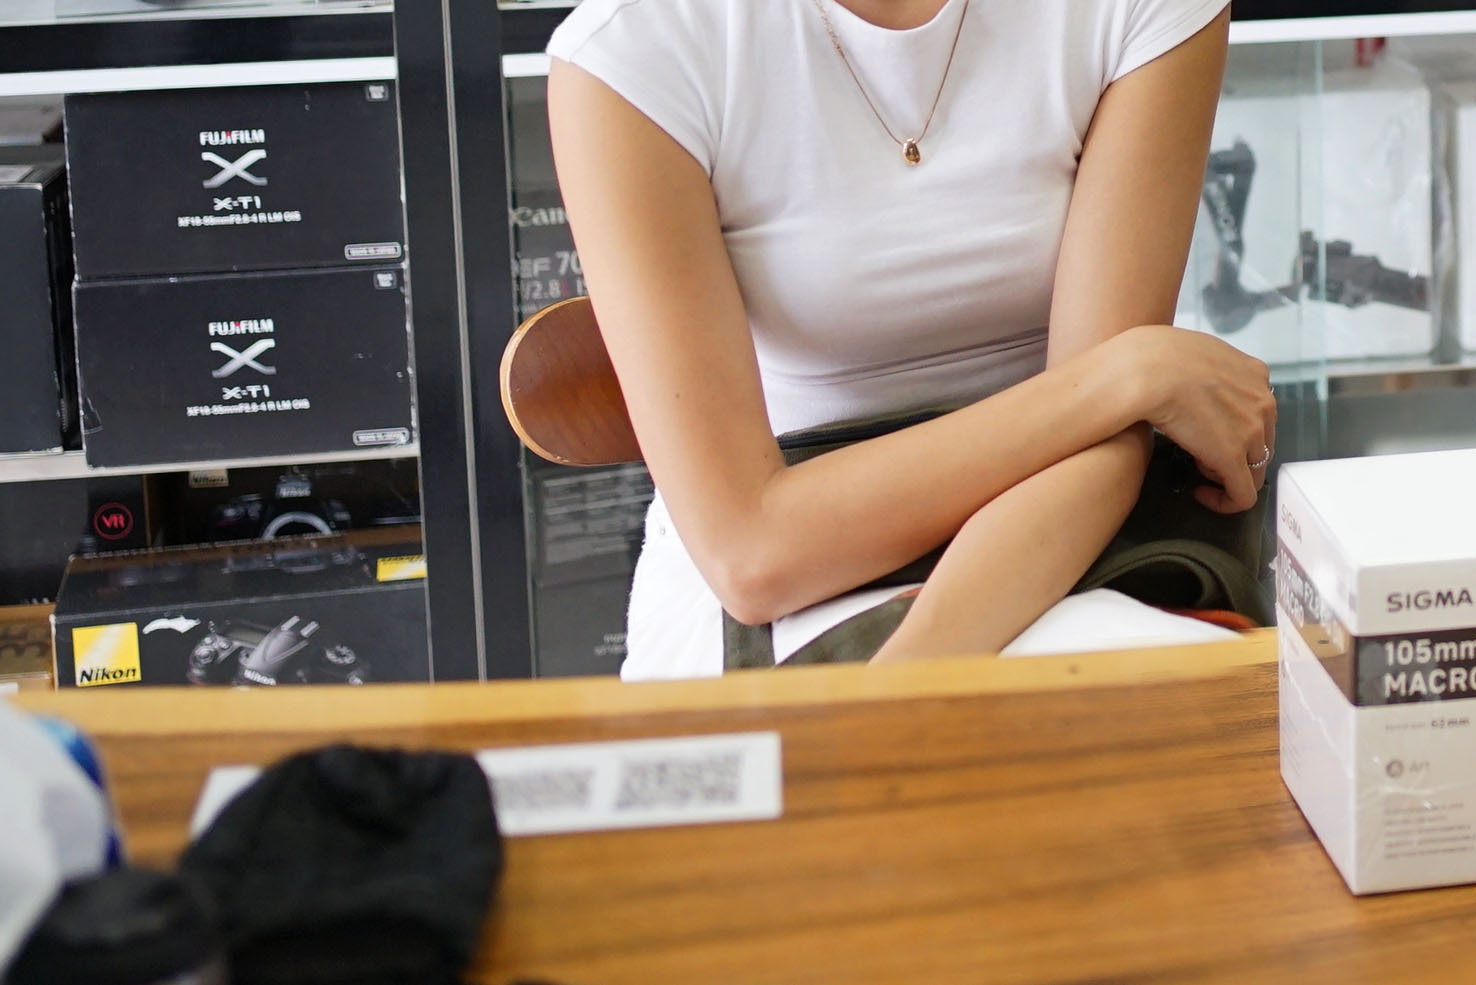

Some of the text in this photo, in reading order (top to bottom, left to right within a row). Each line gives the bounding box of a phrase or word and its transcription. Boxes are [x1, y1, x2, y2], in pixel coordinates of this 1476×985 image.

[213, 196, 262, 211] X-T1
[222, 384, 271, 400] X-T1
[1281, 504, 1303, 544] SIGMA
[1387, 588, 1473, 613] SIGMA
[80, 667, 137, 683] Nikon
